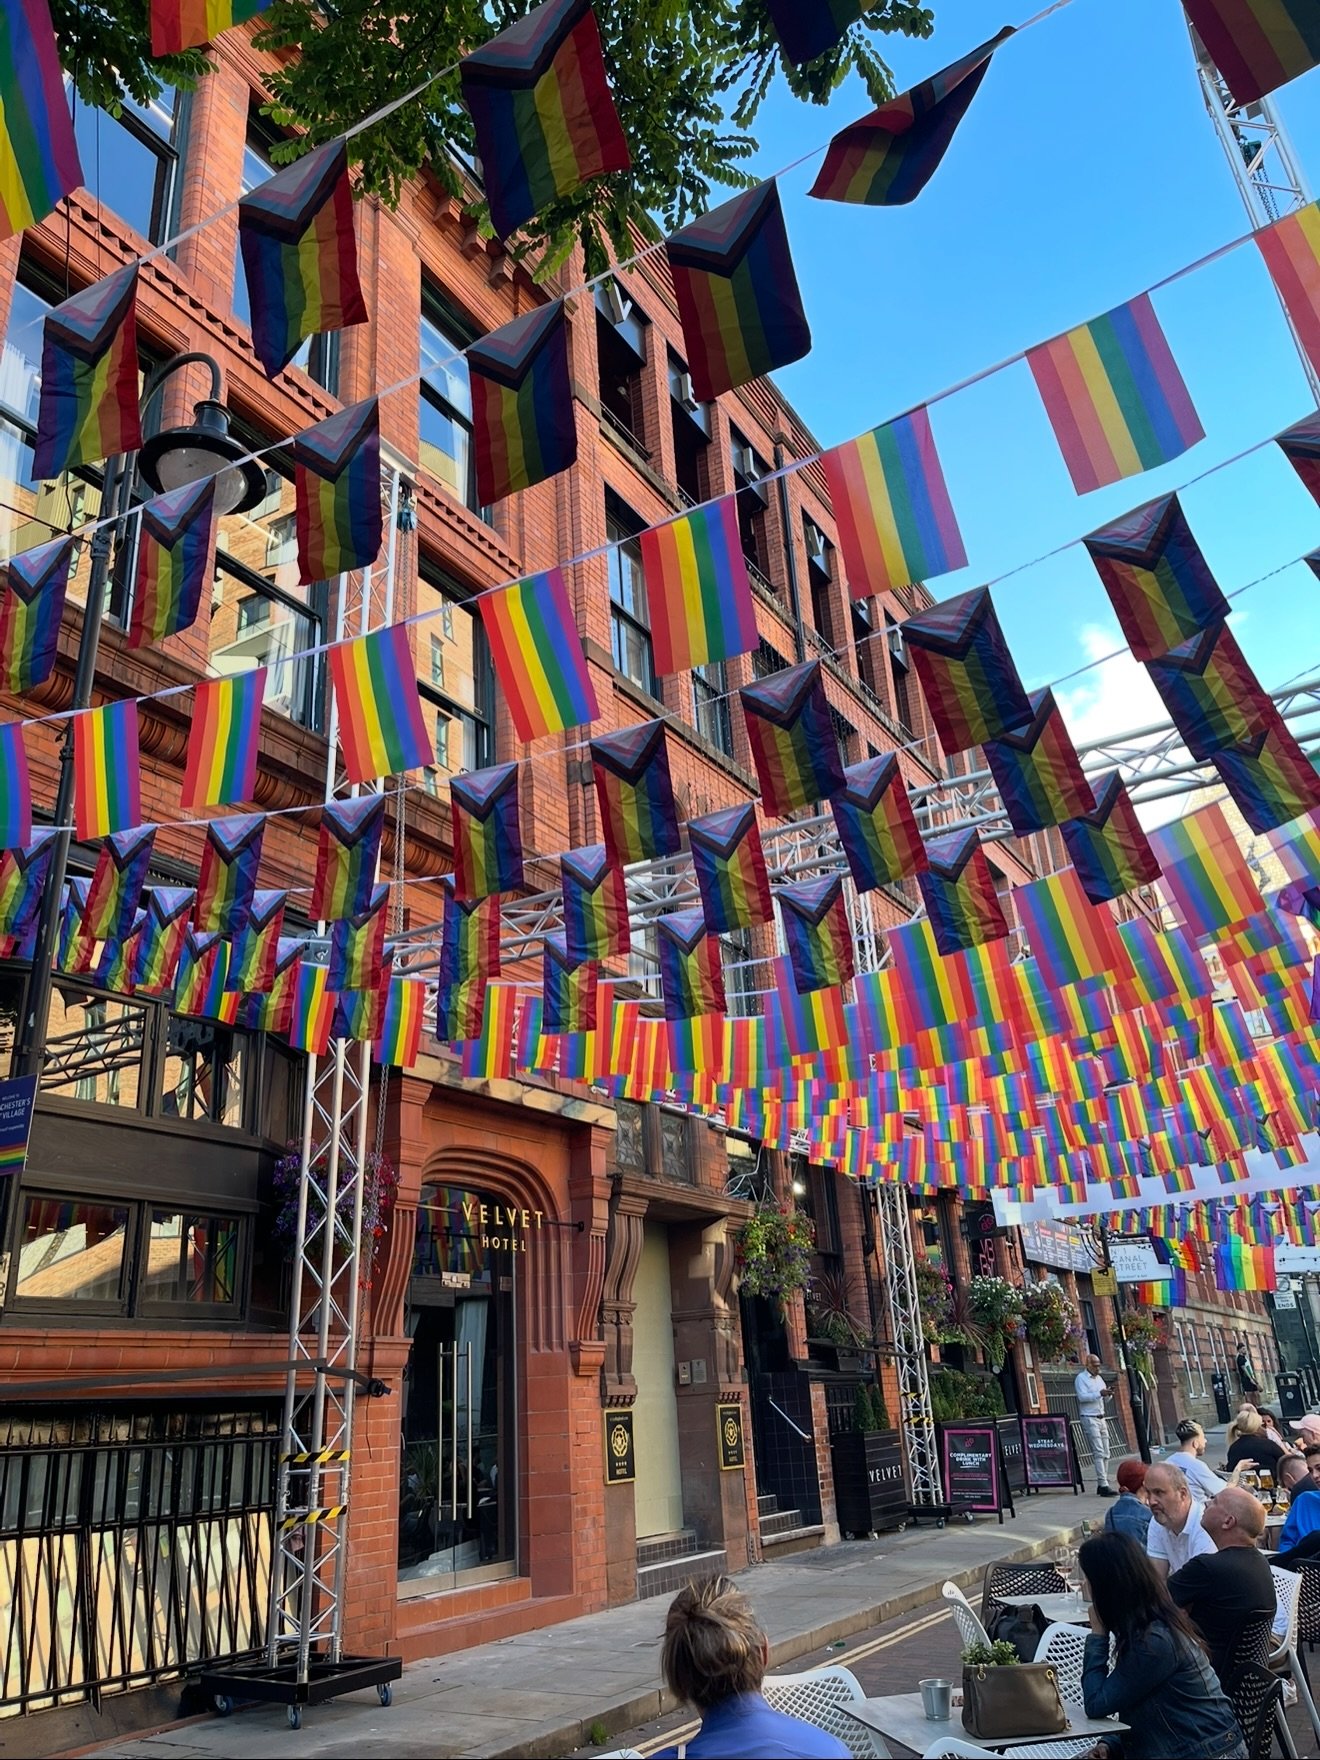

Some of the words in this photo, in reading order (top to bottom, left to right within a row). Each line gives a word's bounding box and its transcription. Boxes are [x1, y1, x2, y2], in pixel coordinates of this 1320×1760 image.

[0, 1097, 31, 1110] CHESTER'S
[2, 1107, 25, 1119] VILLAGE
[462, 1201, 543, 1229] VELVET
[482, 1236, 526, 1252] HOTEL
[1112, 1255, 1144, 1263] CANAL
[1114, 1262, 1147, 1271] STREET
[1004, 1443, 1022, 1456] ELVET
[869, 1464, 902, 1483] VELVET
